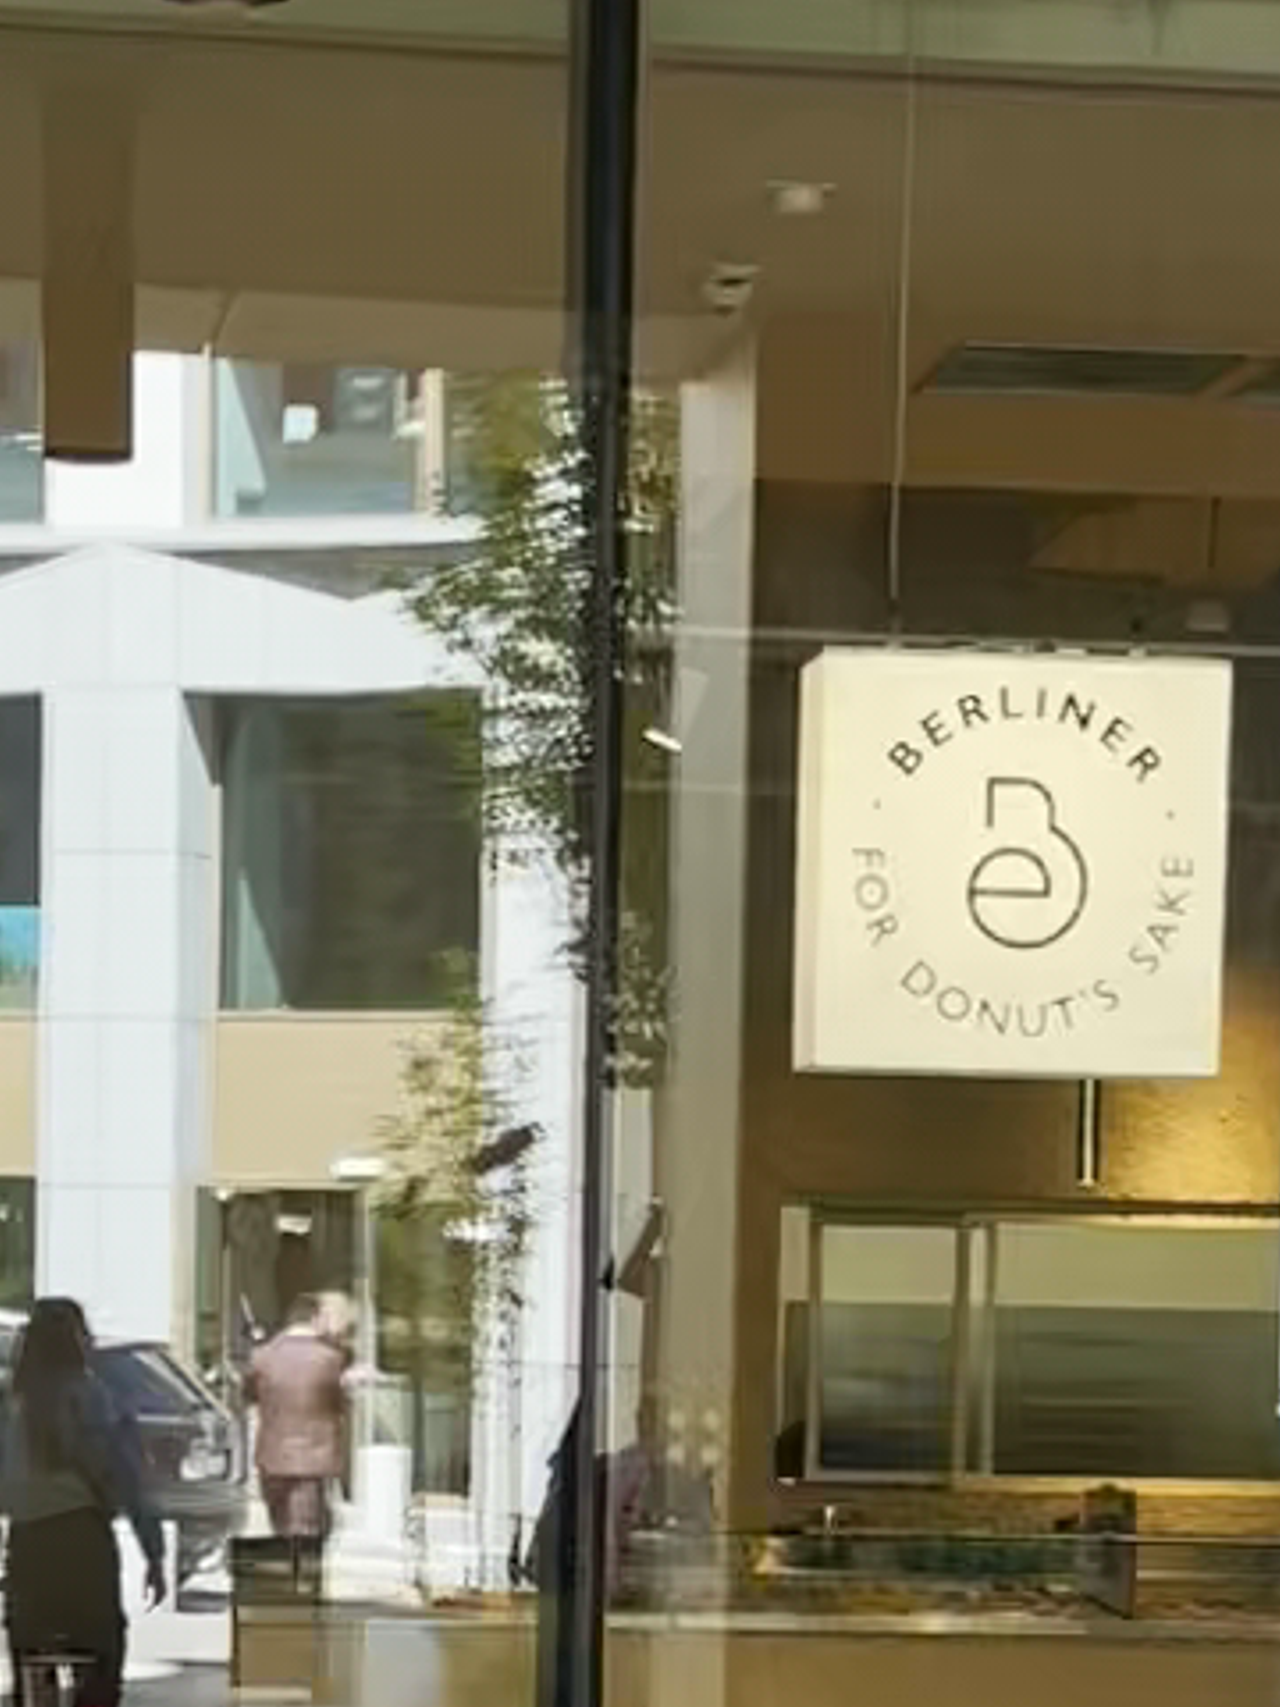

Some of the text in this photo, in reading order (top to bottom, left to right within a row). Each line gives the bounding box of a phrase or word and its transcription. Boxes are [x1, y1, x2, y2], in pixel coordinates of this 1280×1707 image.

[886, 685, 1163, 783] BERLINER
[851, 846, 1195, 1038] FOR DONUT'S SAKE
